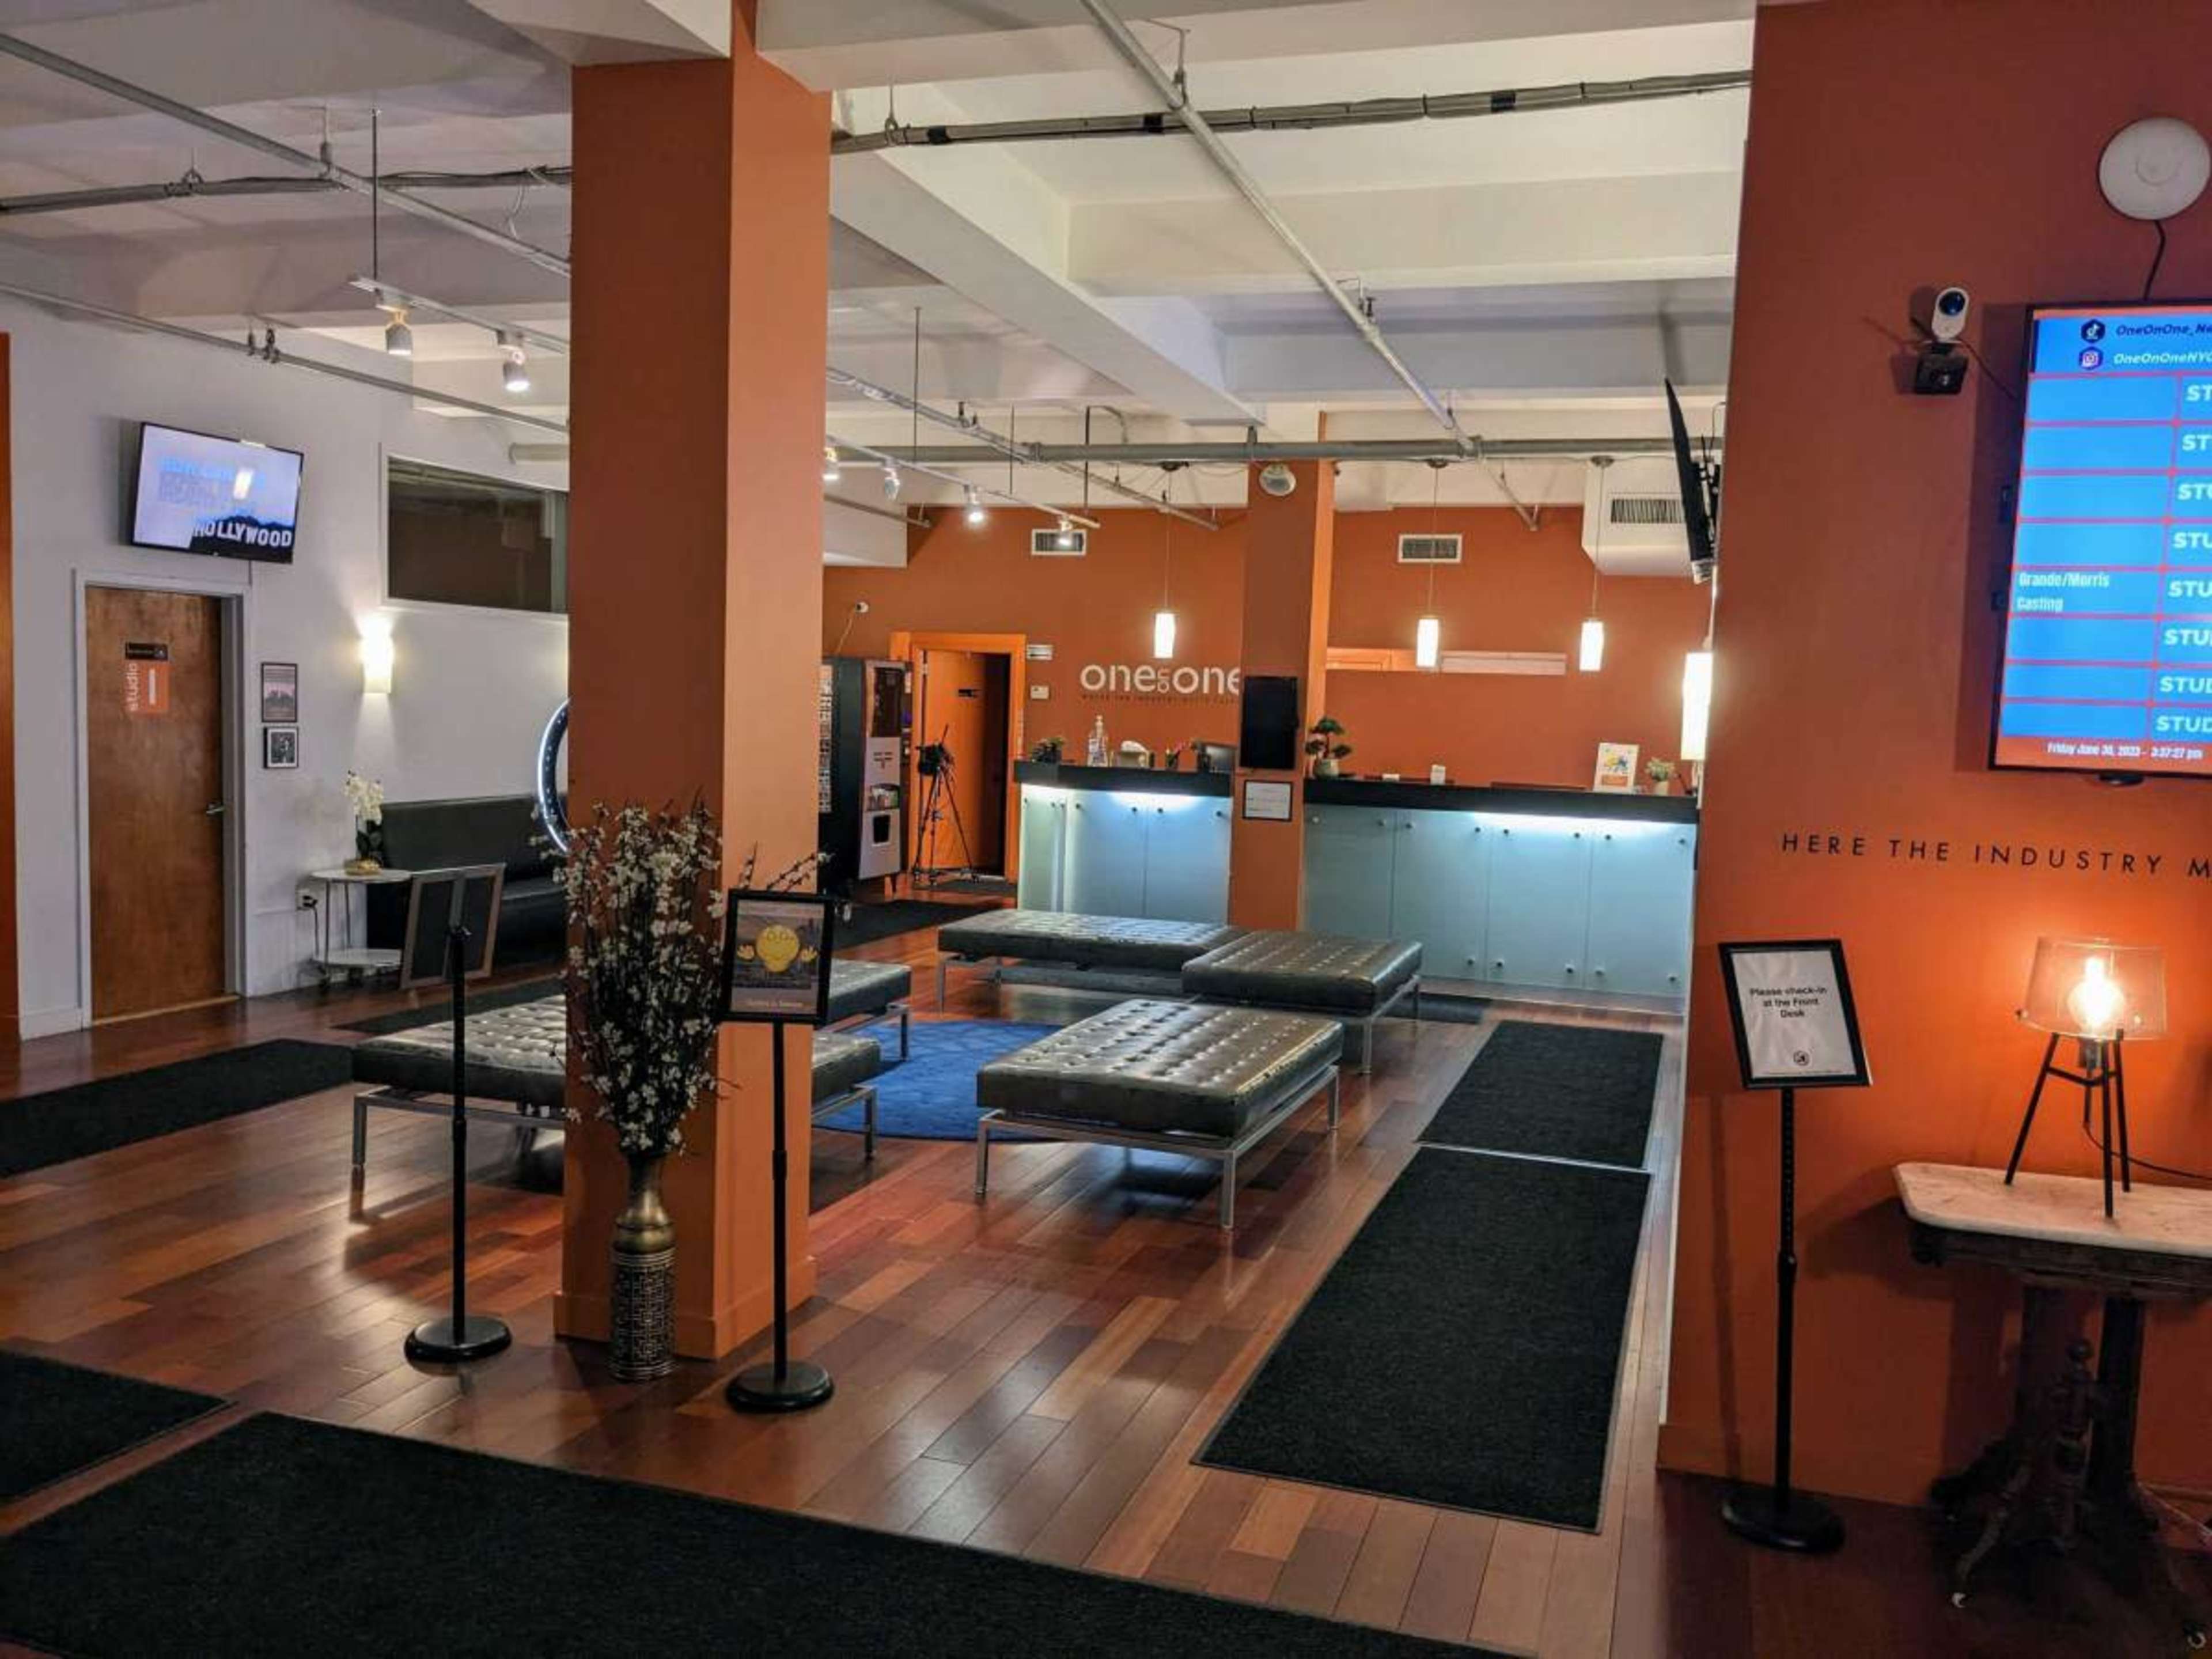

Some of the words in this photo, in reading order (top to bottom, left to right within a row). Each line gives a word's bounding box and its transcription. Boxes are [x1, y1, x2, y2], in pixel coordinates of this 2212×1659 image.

[194, 520, 293, 547] HOLLYWOOD
[2017, 597, 2064, 613] Casting
[126, 663, 139, 712] studio
[1782, 833, 1865, 857] HERE
[1889, 839, 1950, 861] THE
[1974, 844, 2162, 874] INDUSTRY
[1750, 987, 1782, 995] Please
[1785, 986, 1827, 995] check-in
[1775, 998, 1790, 1007] the
[1793, 997, 1819, 1006] Front
[1780, 1009, 1805, 1018] Desk
